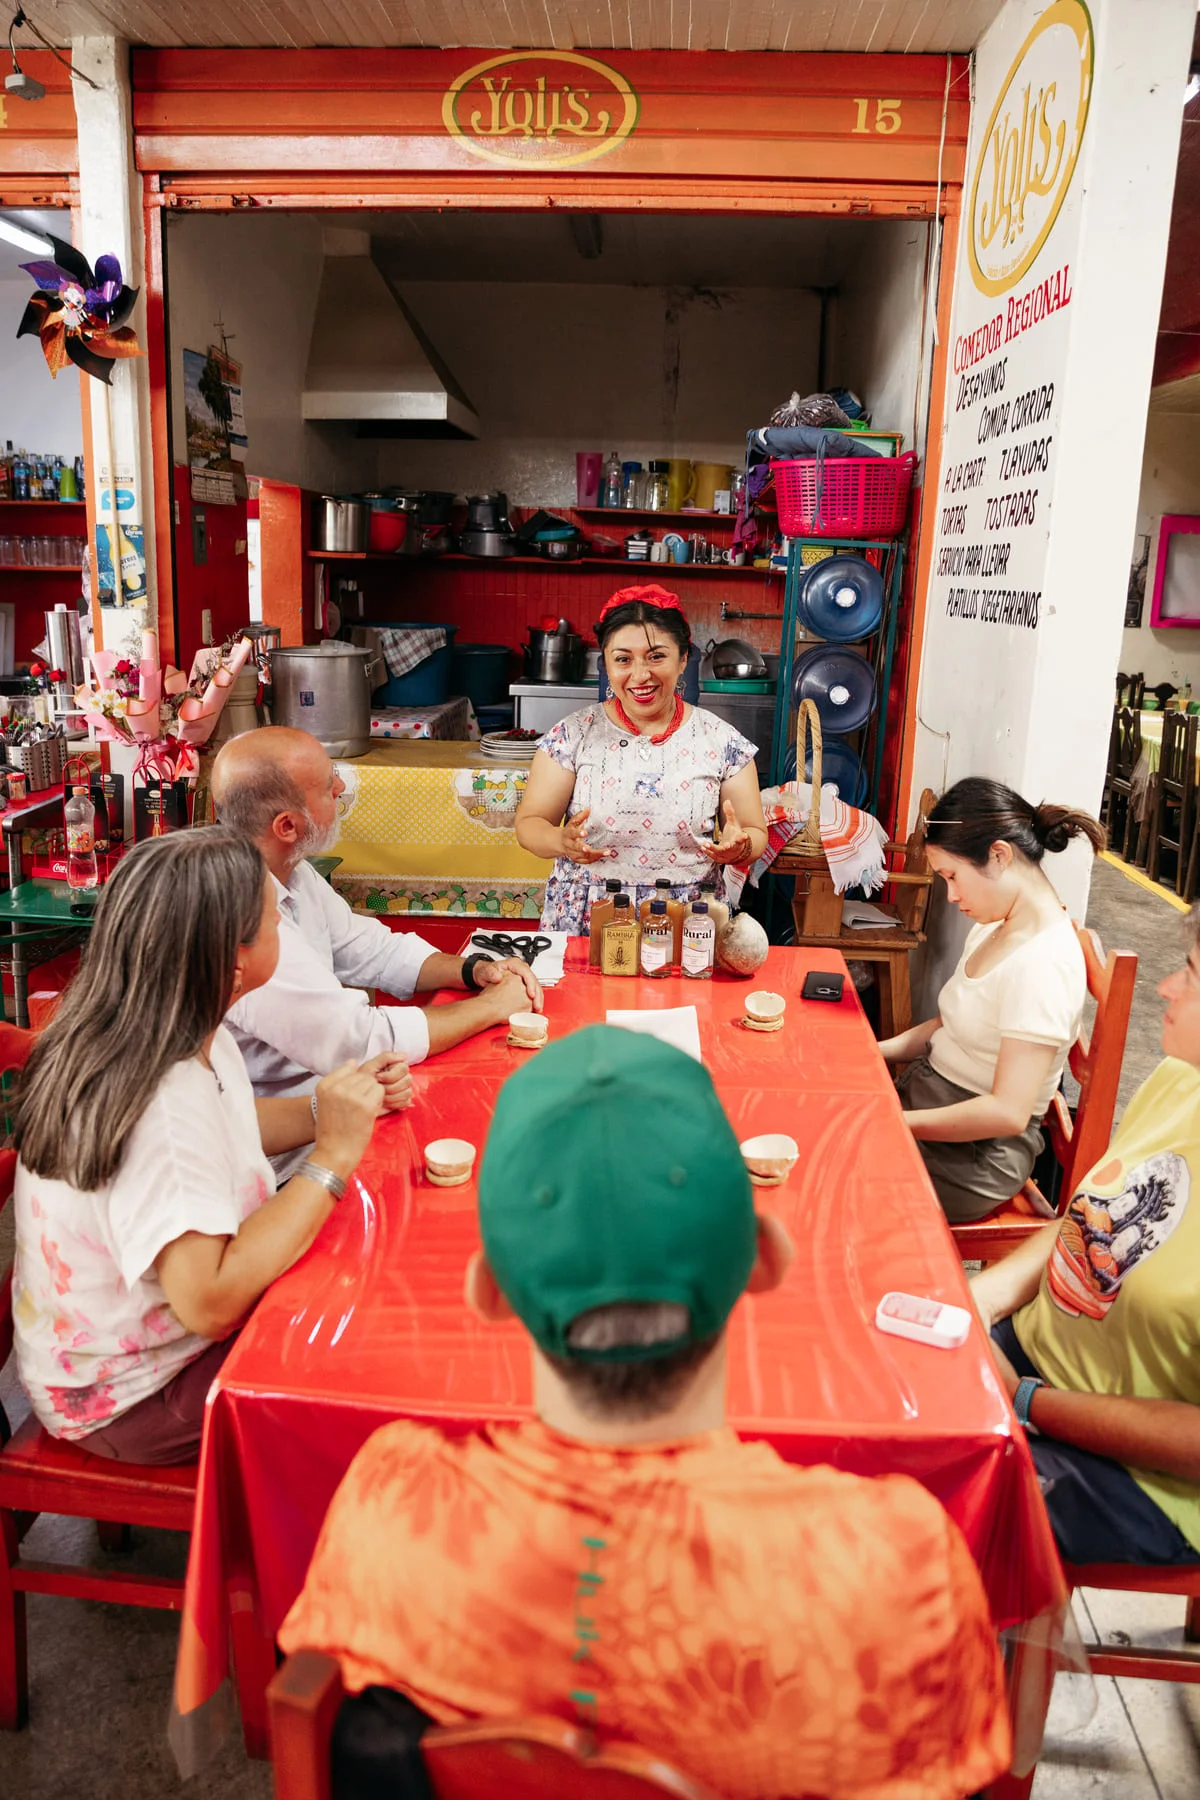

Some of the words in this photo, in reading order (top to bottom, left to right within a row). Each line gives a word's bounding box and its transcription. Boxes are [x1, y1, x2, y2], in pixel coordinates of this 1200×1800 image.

[850, 97, 904, 134] 15
[953, 313, 1003, 376] COMEDOR
[1004, 264, 1073, 344] REGIONAL
[955, 357, 1009, 412] DESAYUNOS
[977, 400, 1011, 445] COMIDA
[1011, 382, 1055, 433] CORRIDA
[998, 435, 1052, 481] TLAYUDAS
[943, 467, 952, 493] A
[951, 463, 963, 493] LA
[940, 504, 968, 536] TORTAS
[983, 489, 1038, 531] TOSTADAS
[963, 544, 983, 577] PARA
[981, 542, 1011, 577] LLEVAR
[945, 588, 980, 619] PLATILLOS
[643, 926, 668, 936] ural
[683, 927, 712, 939] Rural
